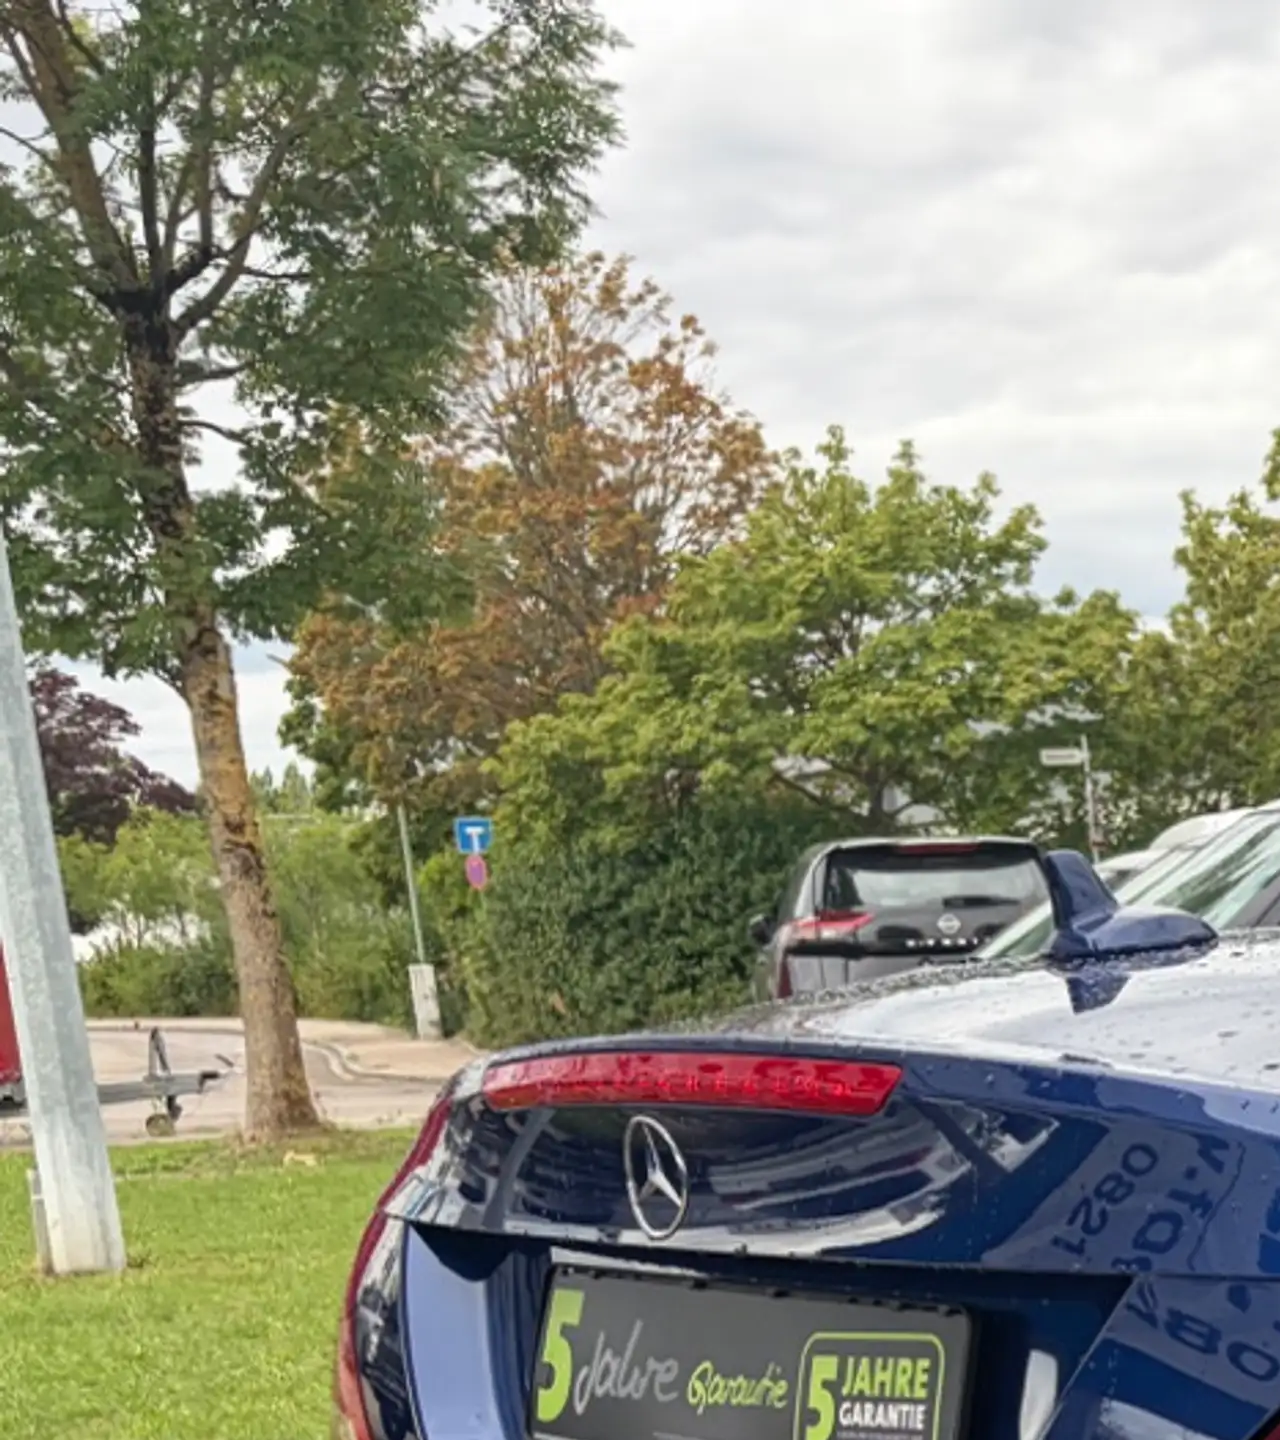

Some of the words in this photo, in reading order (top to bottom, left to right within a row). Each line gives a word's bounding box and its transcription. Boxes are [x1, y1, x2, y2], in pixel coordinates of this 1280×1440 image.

[537, 1289, 585, 1422] 5
[574, 1319, 680, 1416] Jahre
[687, 1359, 790, 1416] Garantie
[842, 1356, 931, 1398] JAHRE
[838, 1401, 927, 1430] GARANTIE
